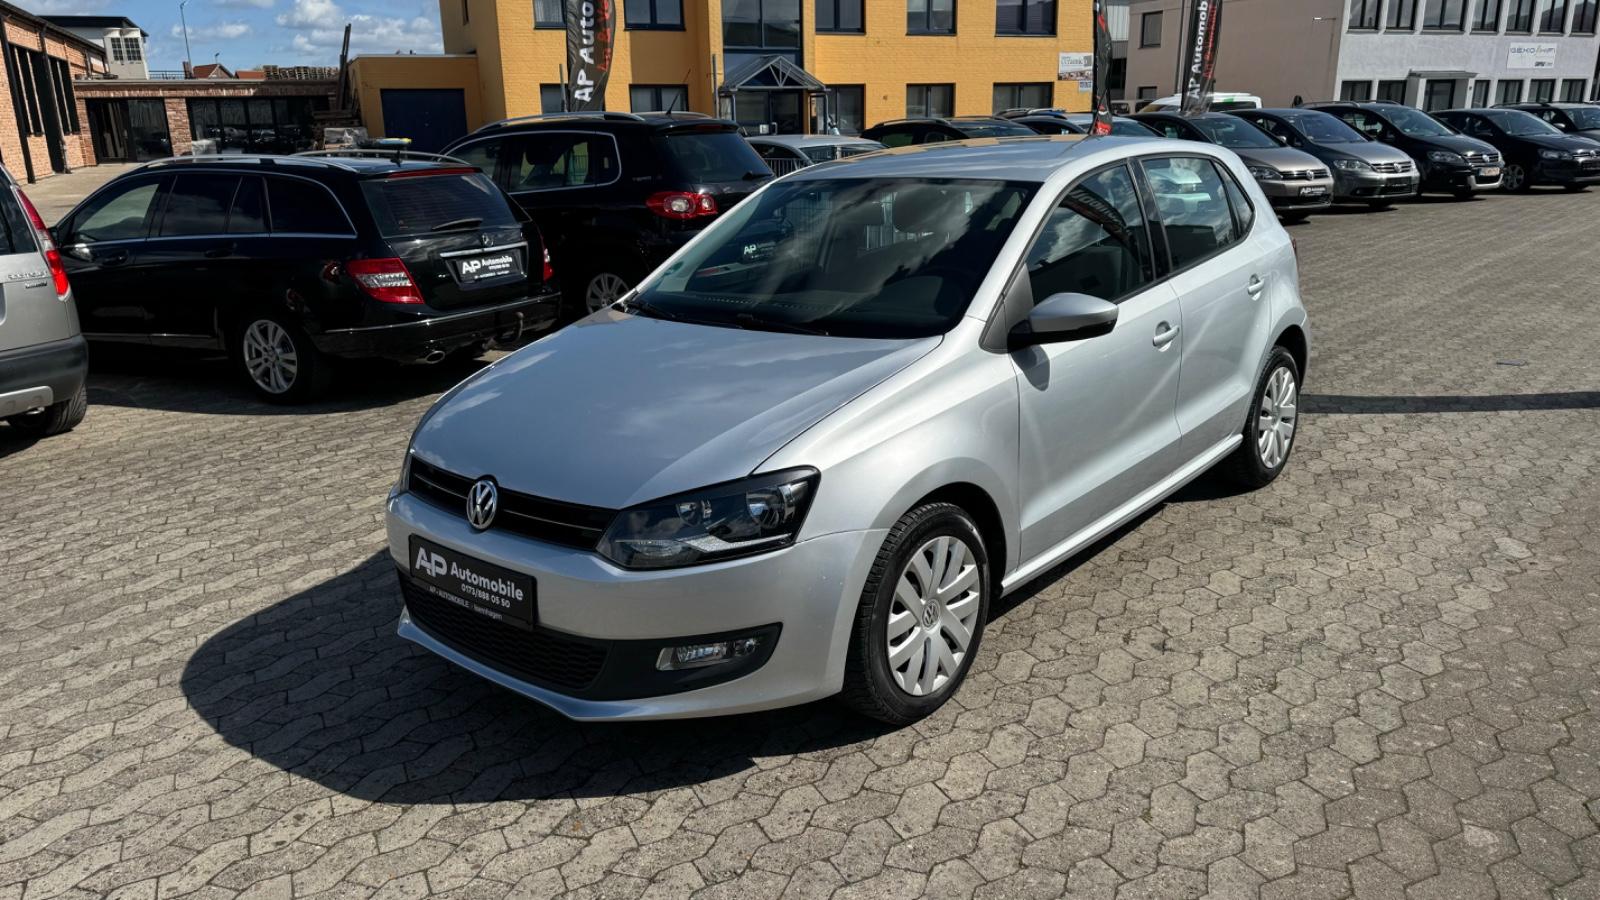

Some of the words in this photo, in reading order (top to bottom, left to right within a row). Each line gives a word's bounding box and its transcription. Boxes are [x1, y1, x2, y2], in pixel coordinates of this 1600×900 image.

[574, 69, 594, 102] AP
[1187, 78, 1200, 99] AP
[462, 260, 481, 274] AP
[415, 547, 448, 577] AP
[451, 561, 524, 600] Automobile
[491, 596, 500, 605] 05
[501, 599, 511, 608] 50
